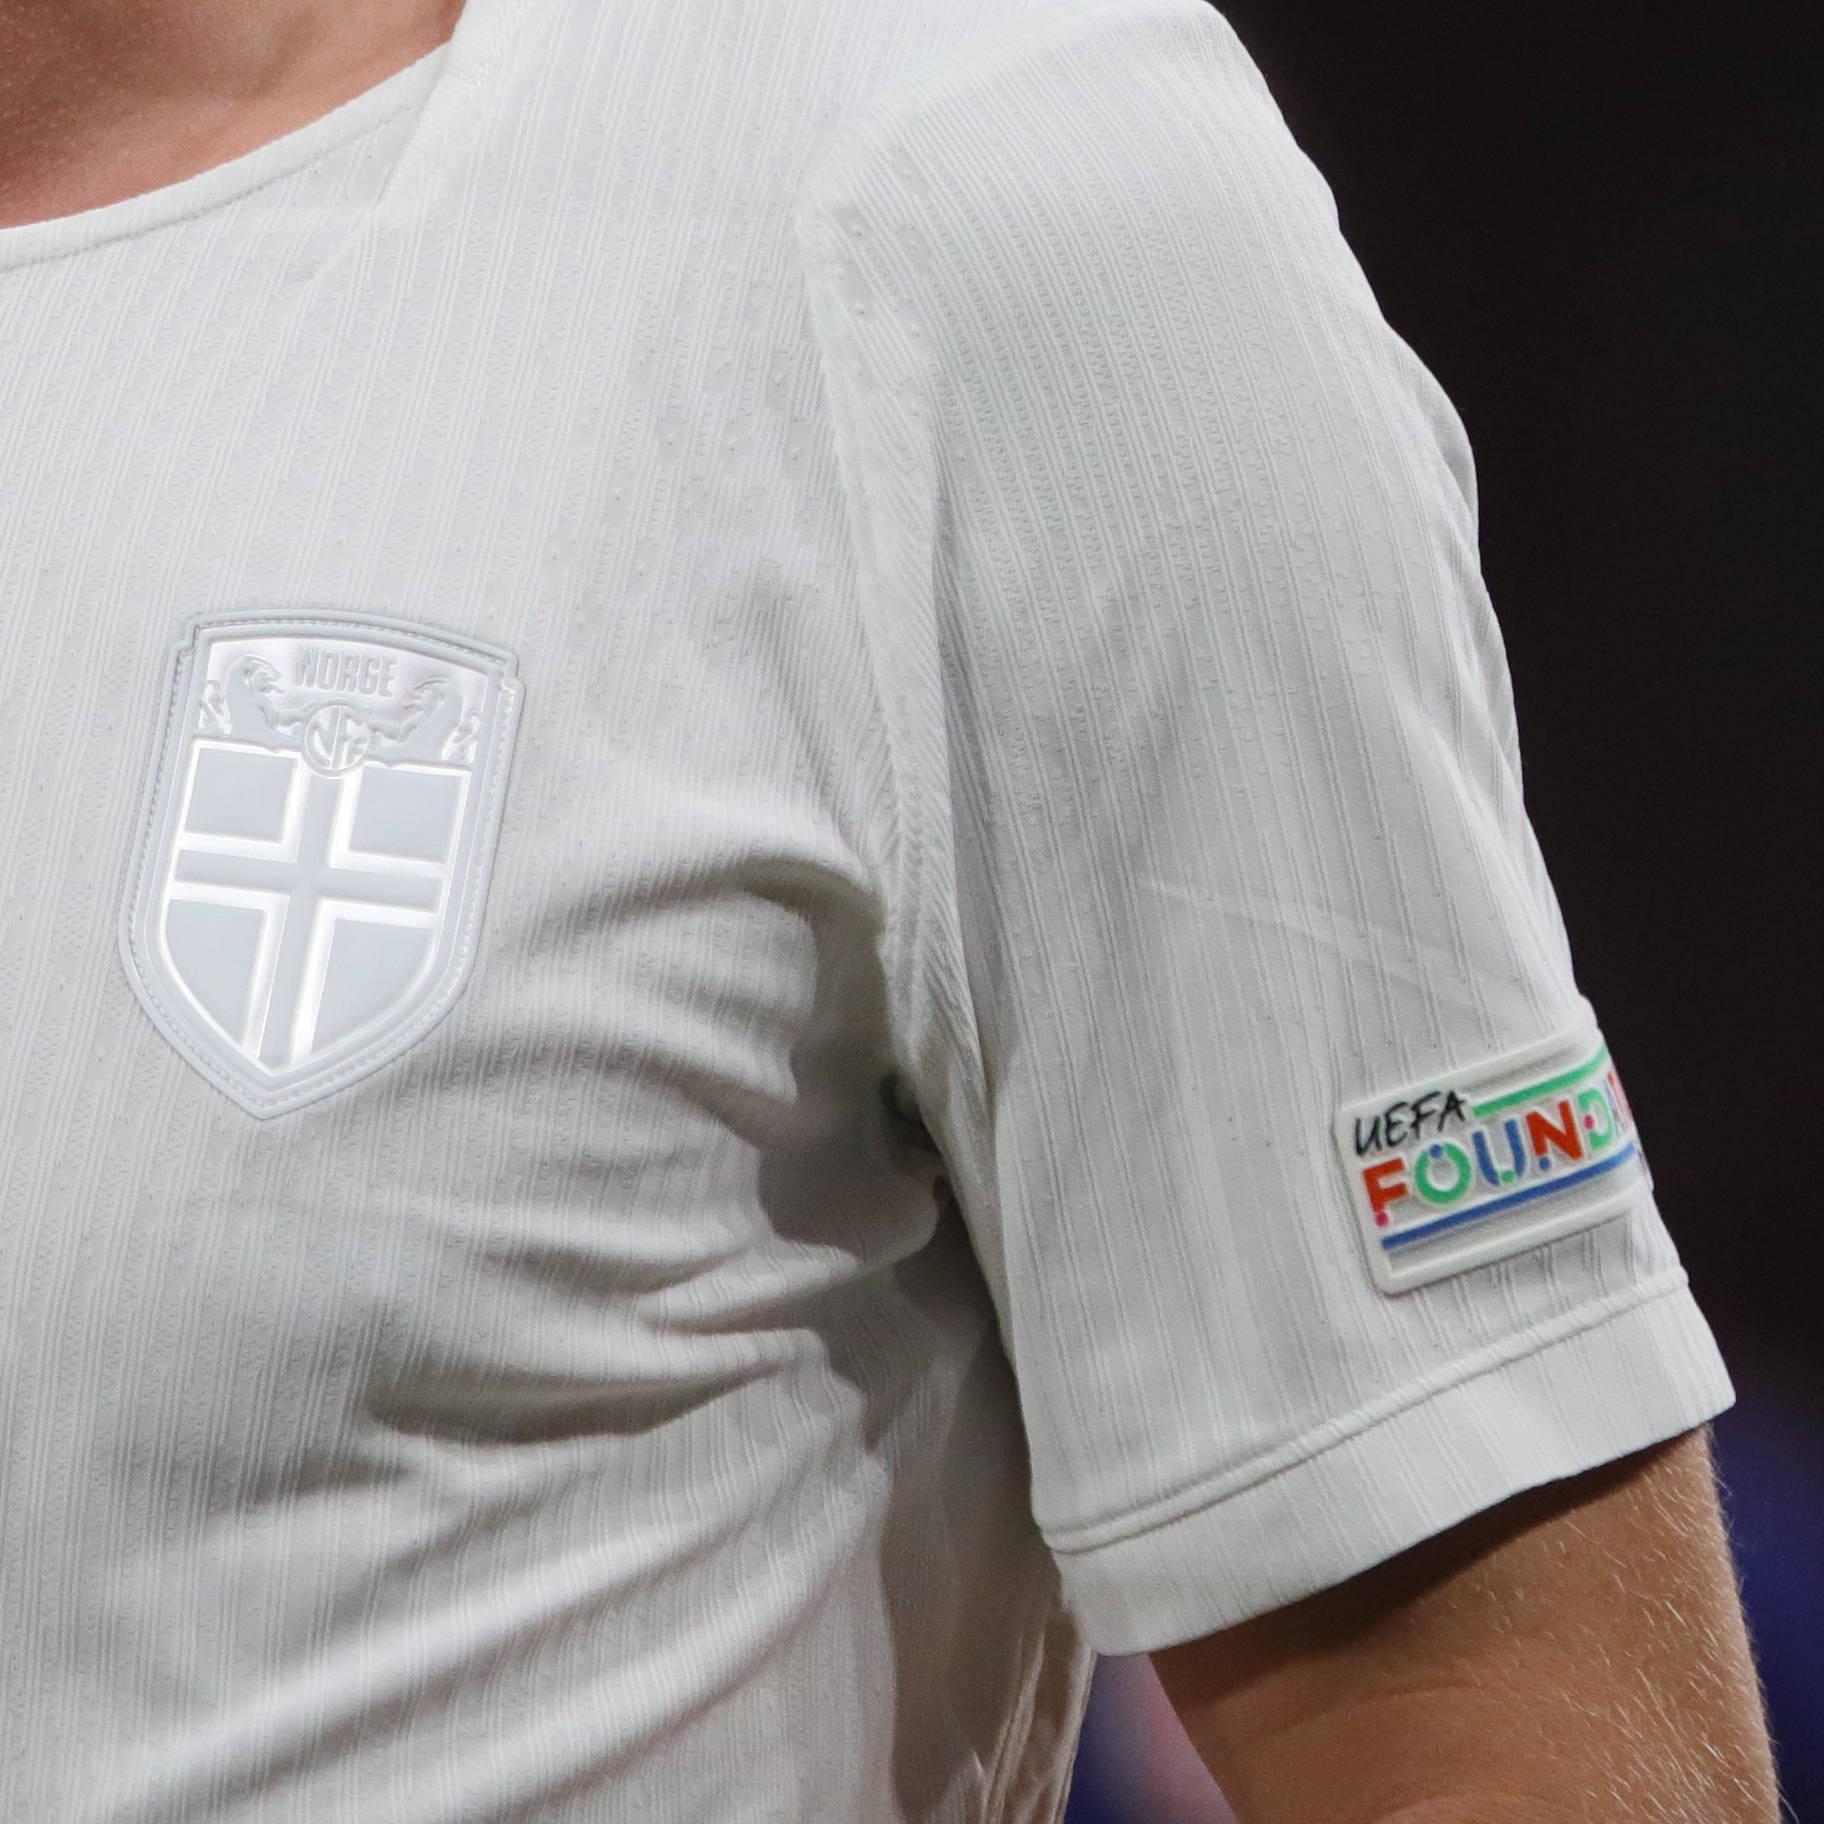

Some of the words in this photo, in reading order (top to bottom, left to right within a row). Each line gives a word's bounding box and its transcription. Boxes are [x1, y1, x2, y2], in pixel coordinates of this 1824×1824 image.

[294, 646, 398, 698] NORGE
[1353, 1090, 1466, 1157] UEFA
[1362, 1070, 1631, 1228] FOUND
